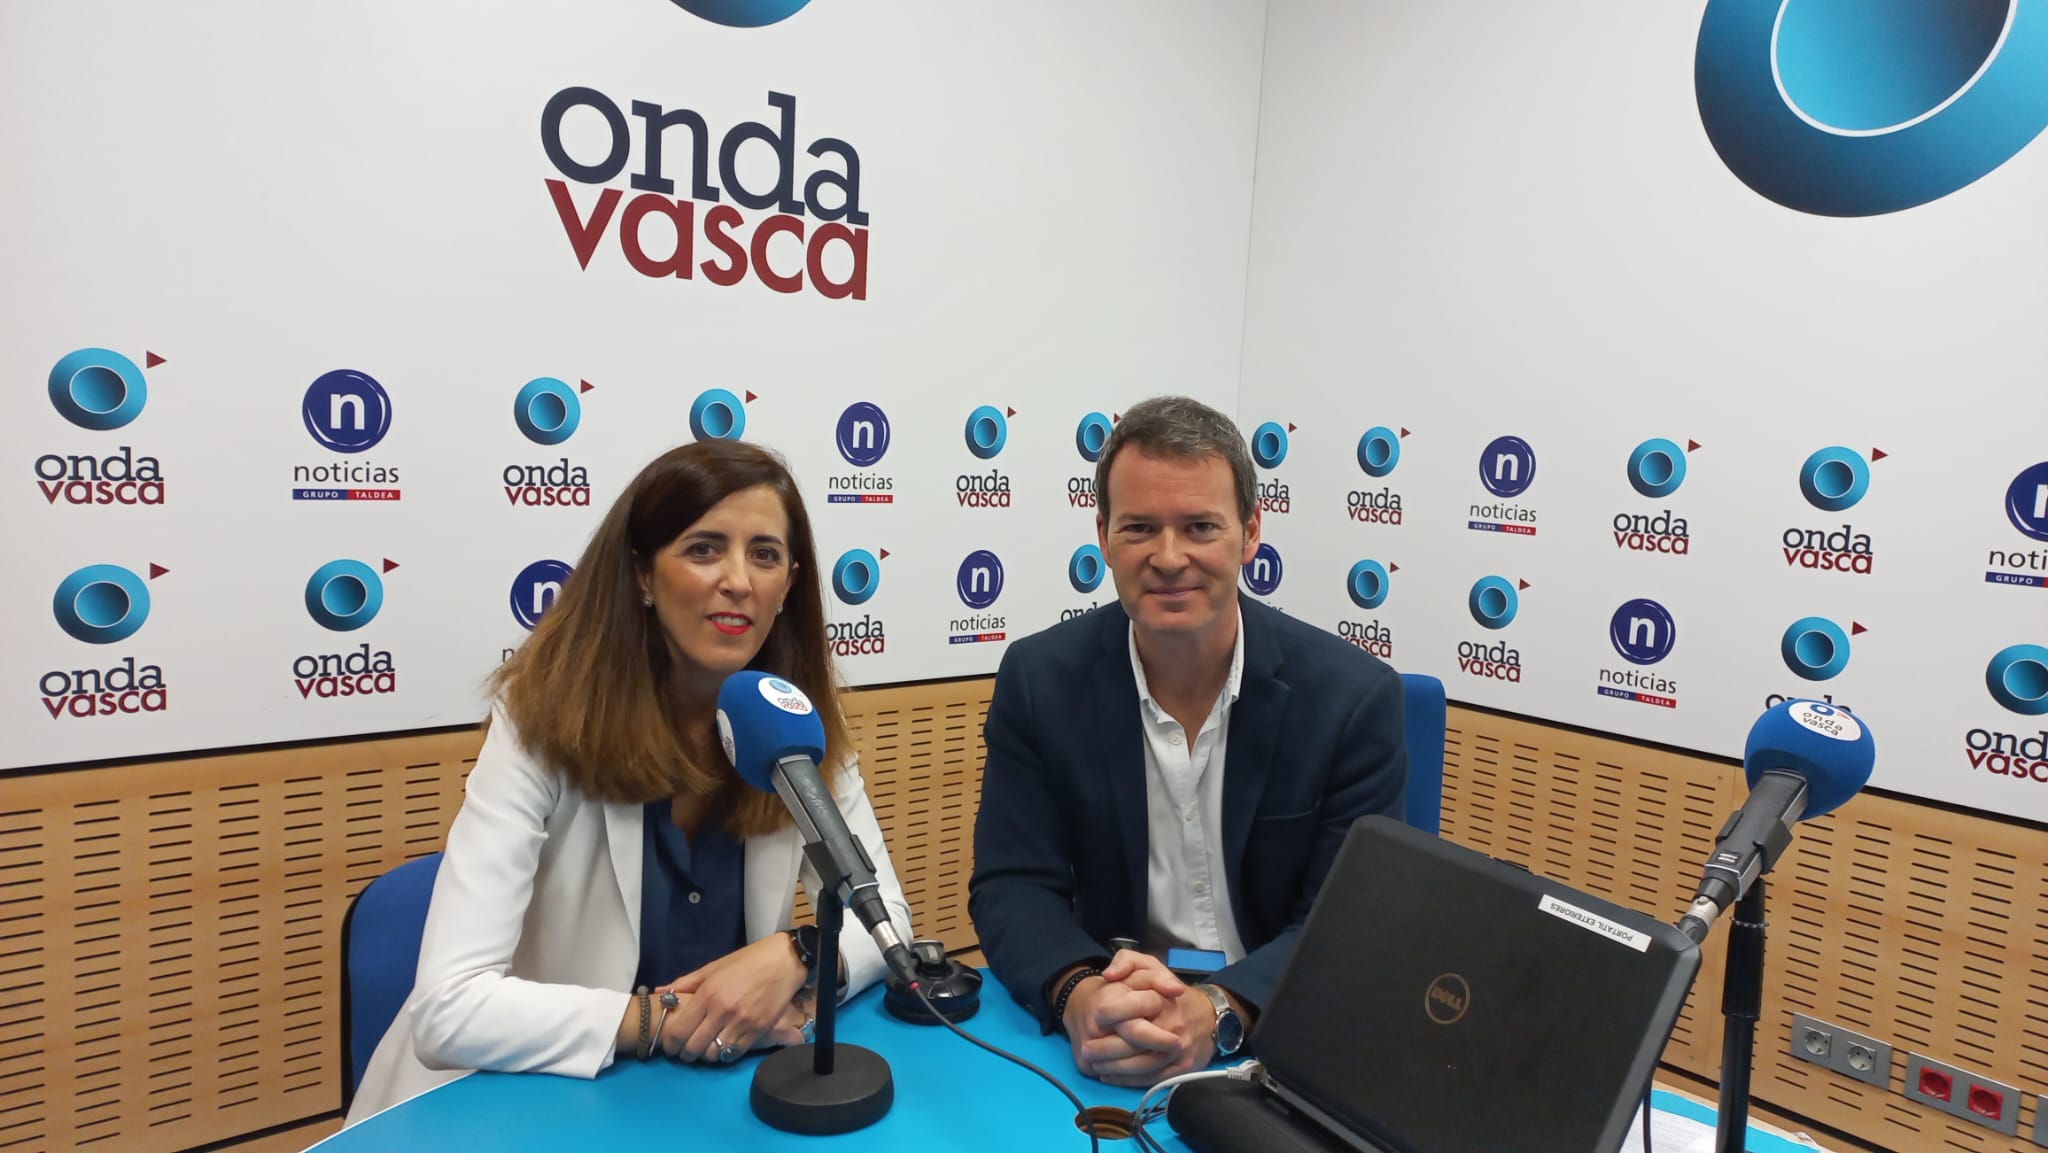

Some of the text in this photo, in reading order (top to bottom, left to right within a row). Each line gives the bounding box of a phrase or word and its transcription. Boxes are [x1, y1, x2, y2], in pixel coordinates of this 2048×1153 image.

[541, 86, 869, 226] onda
[544, 178, 869, 300] vasca
[330, 394, 365, 430] n
[852, 420, 875, 449] n
[35, 446, 164, 482] onda
[294, 461, 399, 483] noticias
[503, 458, 590, 488] onda
[1495, 453, 1519, 481] n
[37, 479, 165, 505] vasca
[829, 472, 893, 490] noticias
[956, 469, 1010, 494] onda
[1257, 478, 1290, 500] nda
[302, 491, 394, 499] GRUPO TALDEA
[504, 485, 590, 507] vasca
[957, 491, 1011, 508] vasca
[1068, 493, 1097, 508] vas
[1257, 498, 1290, 514] sca
[1347, 487, 1402, 511] onda
[1348, 506, 1402, 526] vasca
[1470, 503, 1537, 522] noticias
[1613, 510, 1690, 538] onda
[1473, 522, 1532, 534] GRUPO TALDEA
[1783, 525, 1873, 556] onda
[1614, 532, 1689, 555] vasca
[1253, 557, 1271, 582] n
[1783, 548, 1872, 574] vasca
[1989, 549, 2048, 570] noti
[971, 567, 990, 593] n
[1995, 574, 2034, 584] GRUPO
[950, 613, 1006, 632] noticias
[1338, 619, 1392, 644] onda
[1628, 616, 1656, 648] n
[293, 644, 395, 678] onda
[1458, 641, 1521, 668] onda
[40, 657, 166, 698] onda
[1458, 657, 1521, 683] vasca
[1600, 668, 1677, 694] noticias
[296, 673, 396, 699] vasca
[1604, 689, 1671, 706] GRUPO TALDEA
[41, 687, 167, 720] vasca
[1803, 712, 1843, 731] onda
[1803, 717, 1839, 736] vasca
[1966, 729, 2048, 763] ond
[1966, 748, 2048, 783] vasc
[1550, 902, 1634, 942] PORTATIL EXTERIORES
